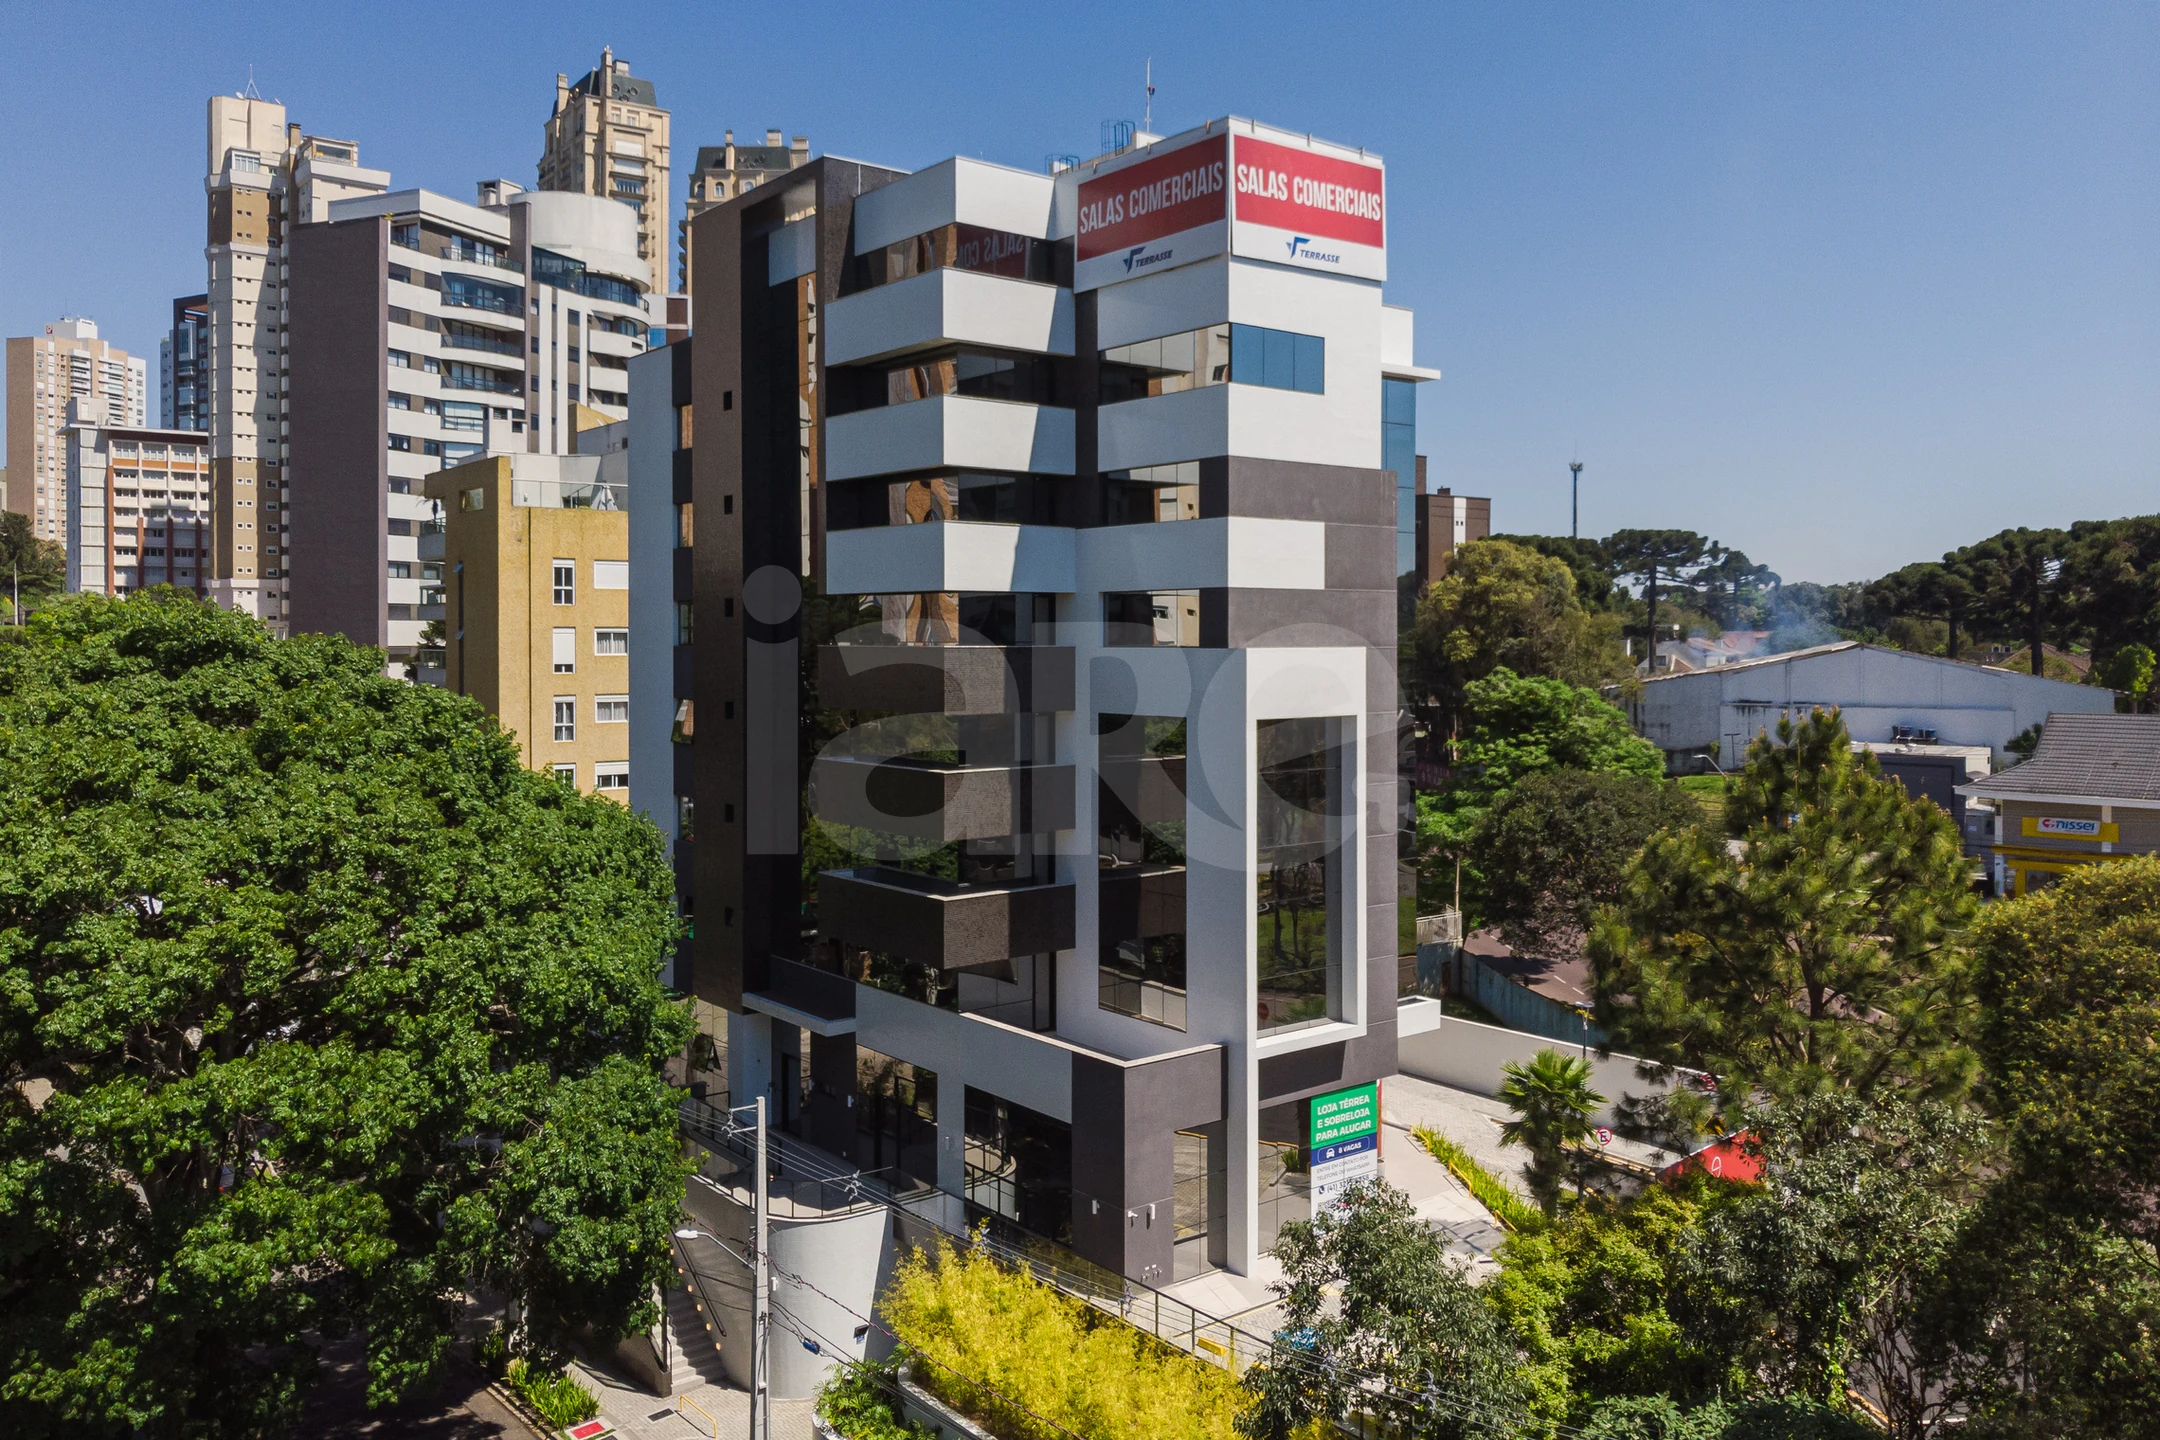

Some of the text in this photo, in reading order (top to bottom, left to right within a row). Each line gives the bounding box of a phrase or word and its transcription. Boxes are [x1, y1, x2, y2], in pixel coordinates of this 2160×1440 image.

[1080, 161, 1223, 234] SALAS COMERCIAIS
[1237, 163, 1381, 221] SALAS COMERCIAIS
[1136, 250, 1173, 268] TERRASSE
[1300, 250, 1341, 264] TERRASSE
[1317, 1094, 1370, 1115] LOJA TÉRREA
[1317, 1107, 1370, 1128] E SOBRELOJA
[1315, 1119, 1372, 1142] PARA ALUGAR
[1343, 1142, 1362, 1153] VAGAS
[1317, 1165, 1331, 1174] ENTRE
